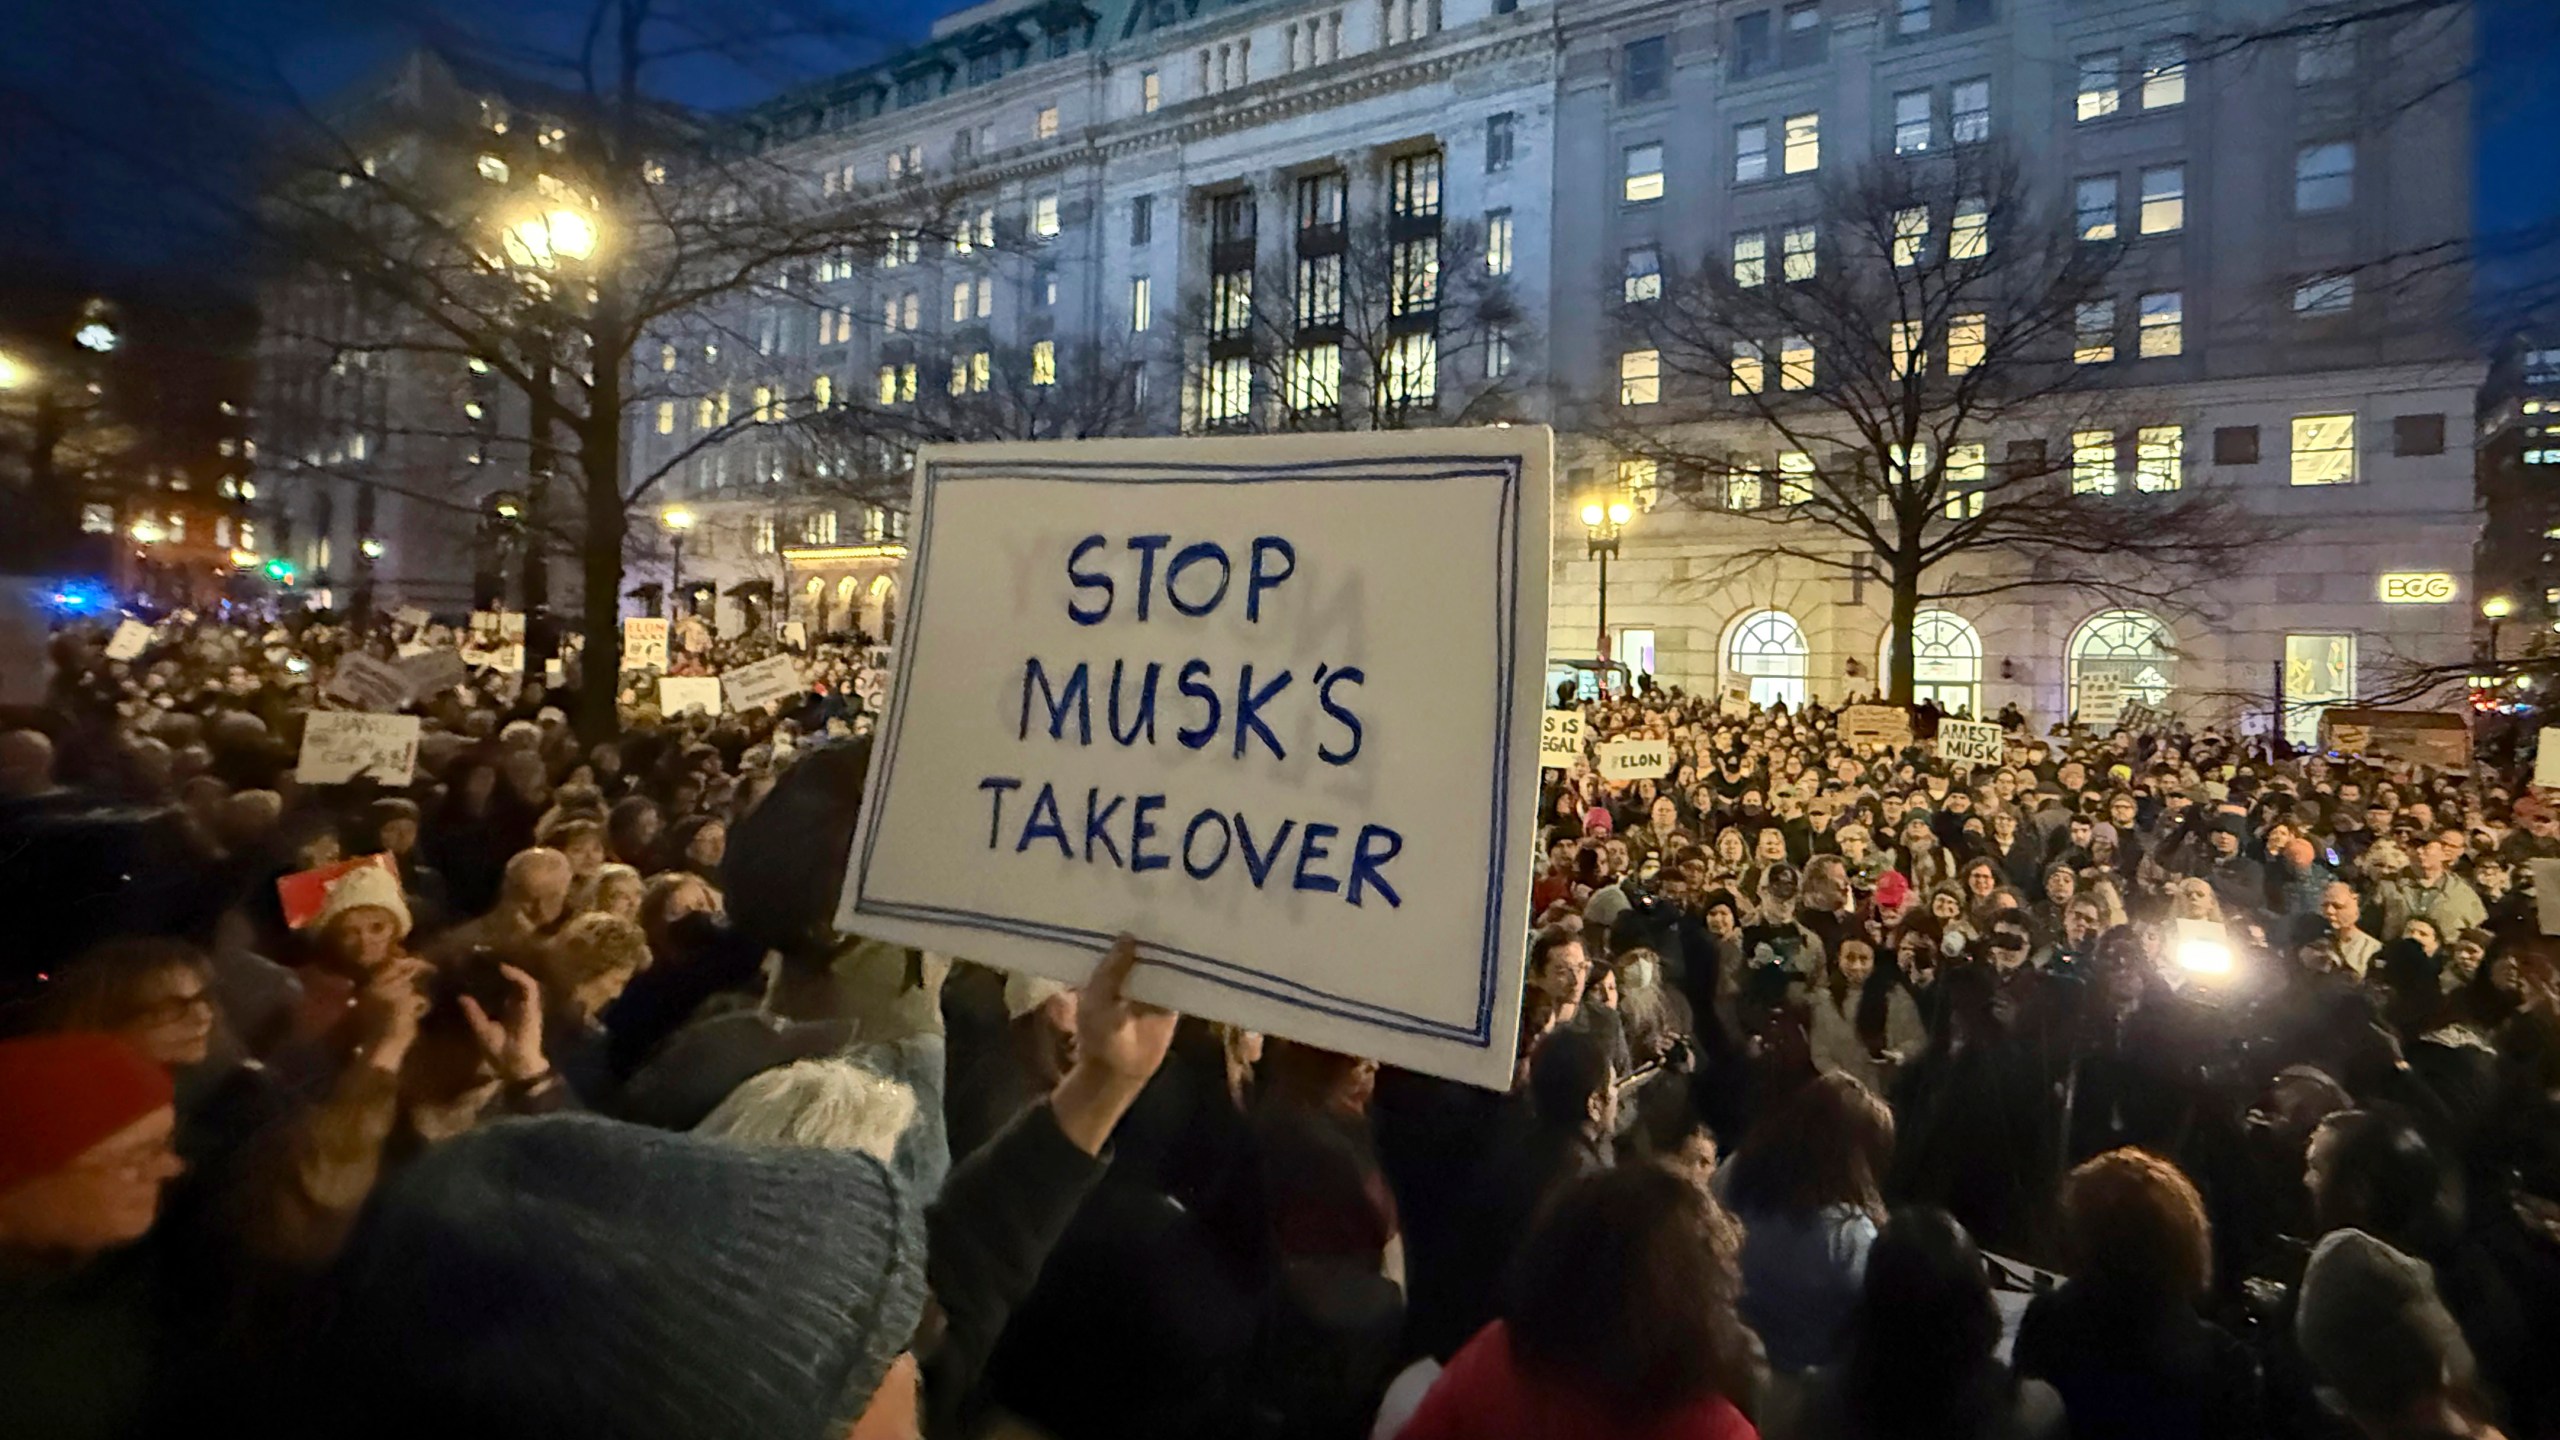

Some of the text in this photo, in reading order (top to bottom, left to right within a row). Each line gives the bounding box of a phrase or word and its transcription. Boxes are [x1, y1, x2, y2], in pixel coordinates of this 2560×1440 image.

[1068, 534, 1295, 626] STOP
[1019, 658, 1365, 765] MUSK'S
[1562, 718, 1579, 734] IS
[1940, 723, 2000, 743] ARREST
[1946, 740, 1999, 761] MUSK
[979, 778, 1402, 908] TAKEOVER
